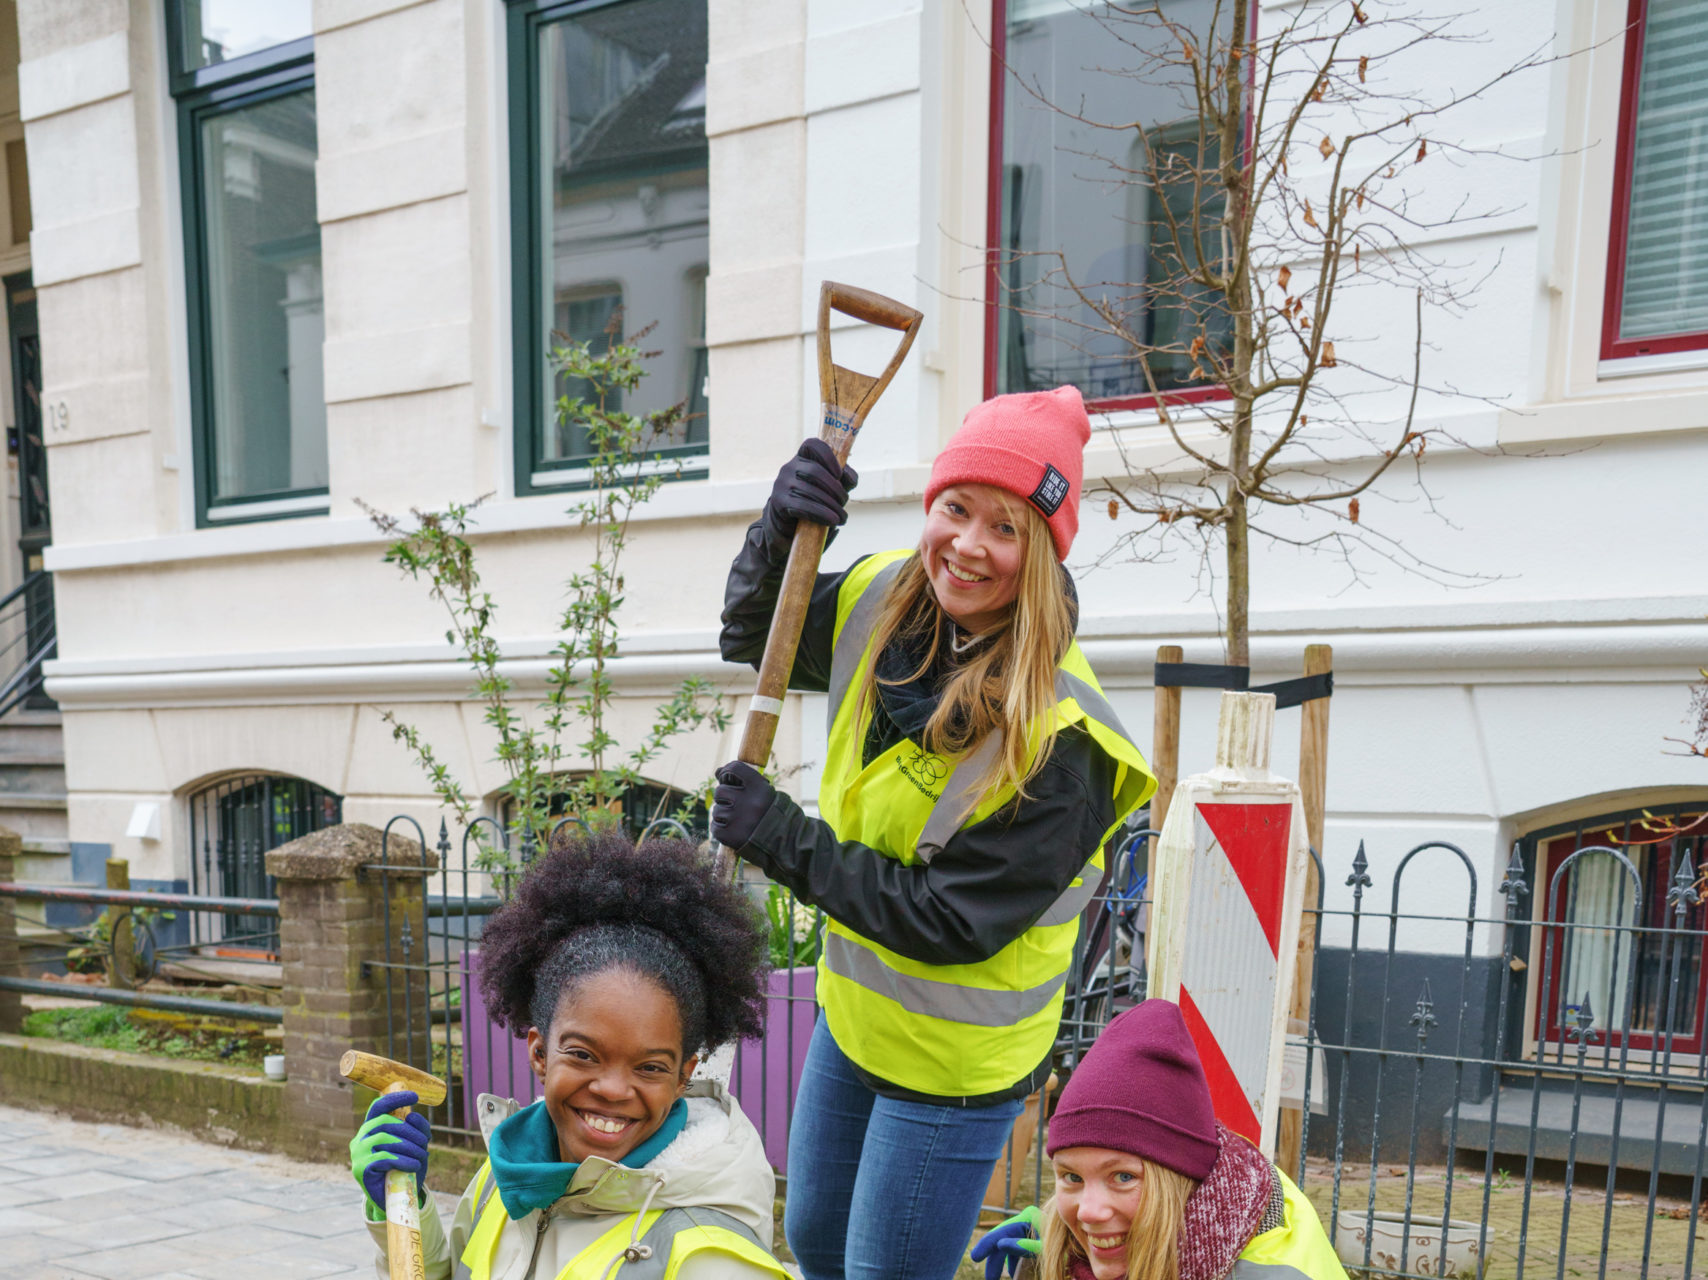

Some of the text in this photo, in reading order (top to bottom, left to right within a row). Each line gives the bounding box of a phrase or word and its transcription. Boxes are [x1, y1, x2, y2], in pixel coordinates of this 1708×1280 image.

[49, 401, 70, 432] 19
[1049, 472, 1060, 486] RIDE
[1041, 488, 1054, 502] STOLE
[1045, 480, 1062, 498] LIKE YOU
[410, 1230, 422, 1250] DE
